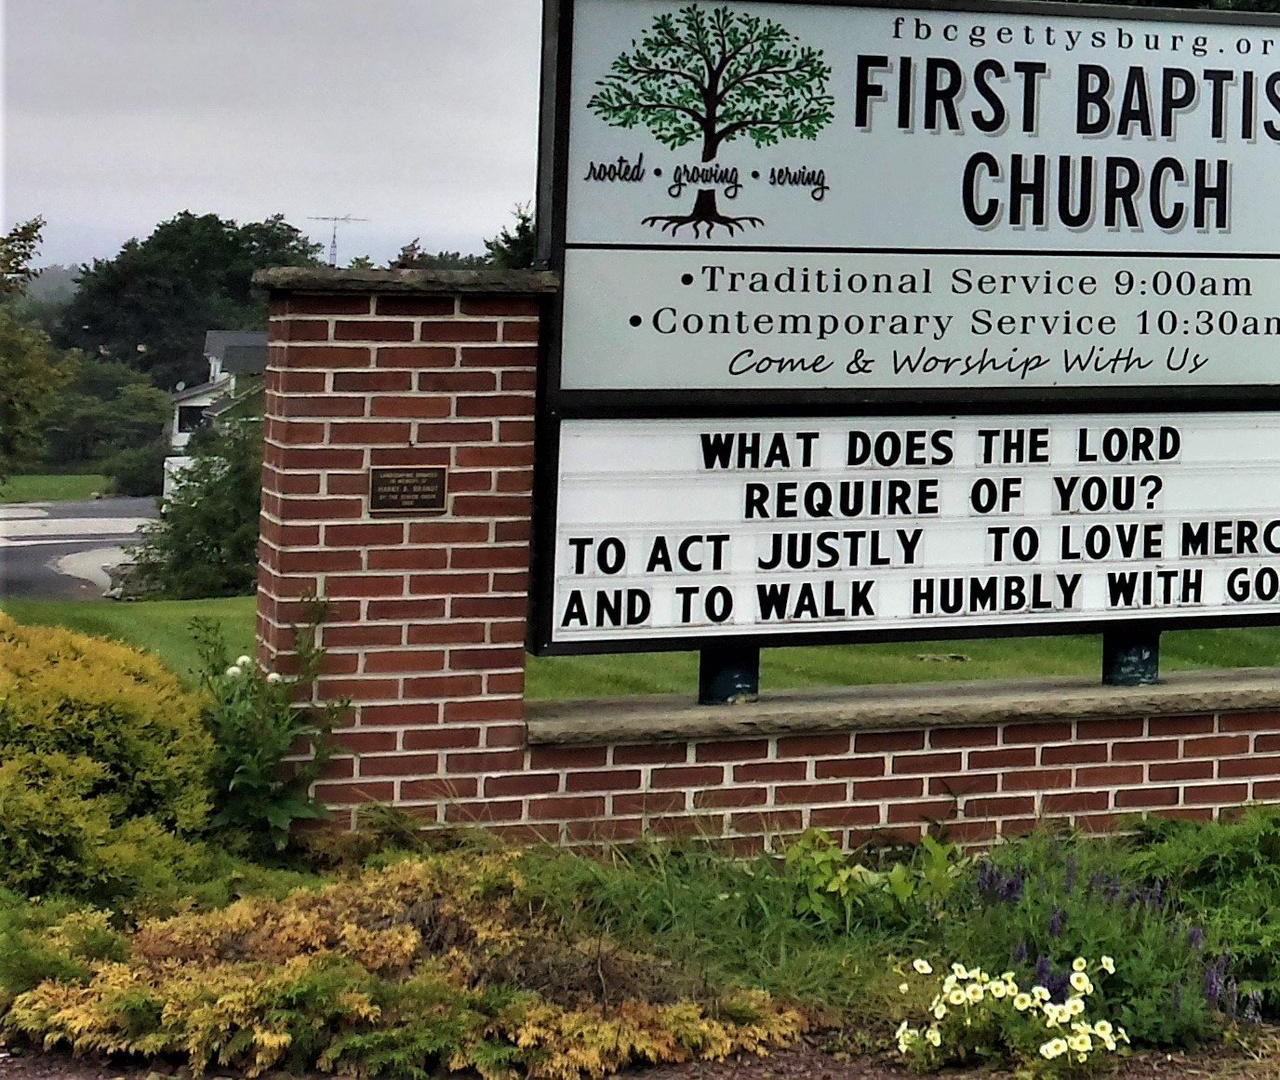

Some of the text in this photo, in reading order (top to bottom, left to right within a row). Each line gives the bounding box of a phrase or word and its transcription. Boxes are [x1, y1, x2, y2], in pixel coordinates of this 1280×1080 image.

[854, 54, 1047, 133] FIRST
[583, 152, 830, 202] rooted growing serving
[962, 151, 1228, 229] CHURCH
[701, 265, 1253, 296] Traditional Service 9:00am
[651, 307, 954, 341] Contemporary
[971, 309, 1116, 335] Service
[728, 345, 1209, 380] Come & Worship With Us
[699, 426, 1181, 470] WHAT DOES THE LORD
[744, 474, 1163, 519] REQUIRE OF YOU?
[568, 537, 626, 575] TO
[646, 534, 730, 573] ACT
[758, 528, 924, 570] JUSTLY
[987, 526, 1039, 562] TO
[1061, 523, 1164, 560] LOVE
[561, 588, 651, 628] AND
[675, 585, 733, 623] TO
[756, 580, 875, 622] WALK
[912, 573, 1082, 614] HUMBLY
[1107, 568, 1203, 608] WITH
